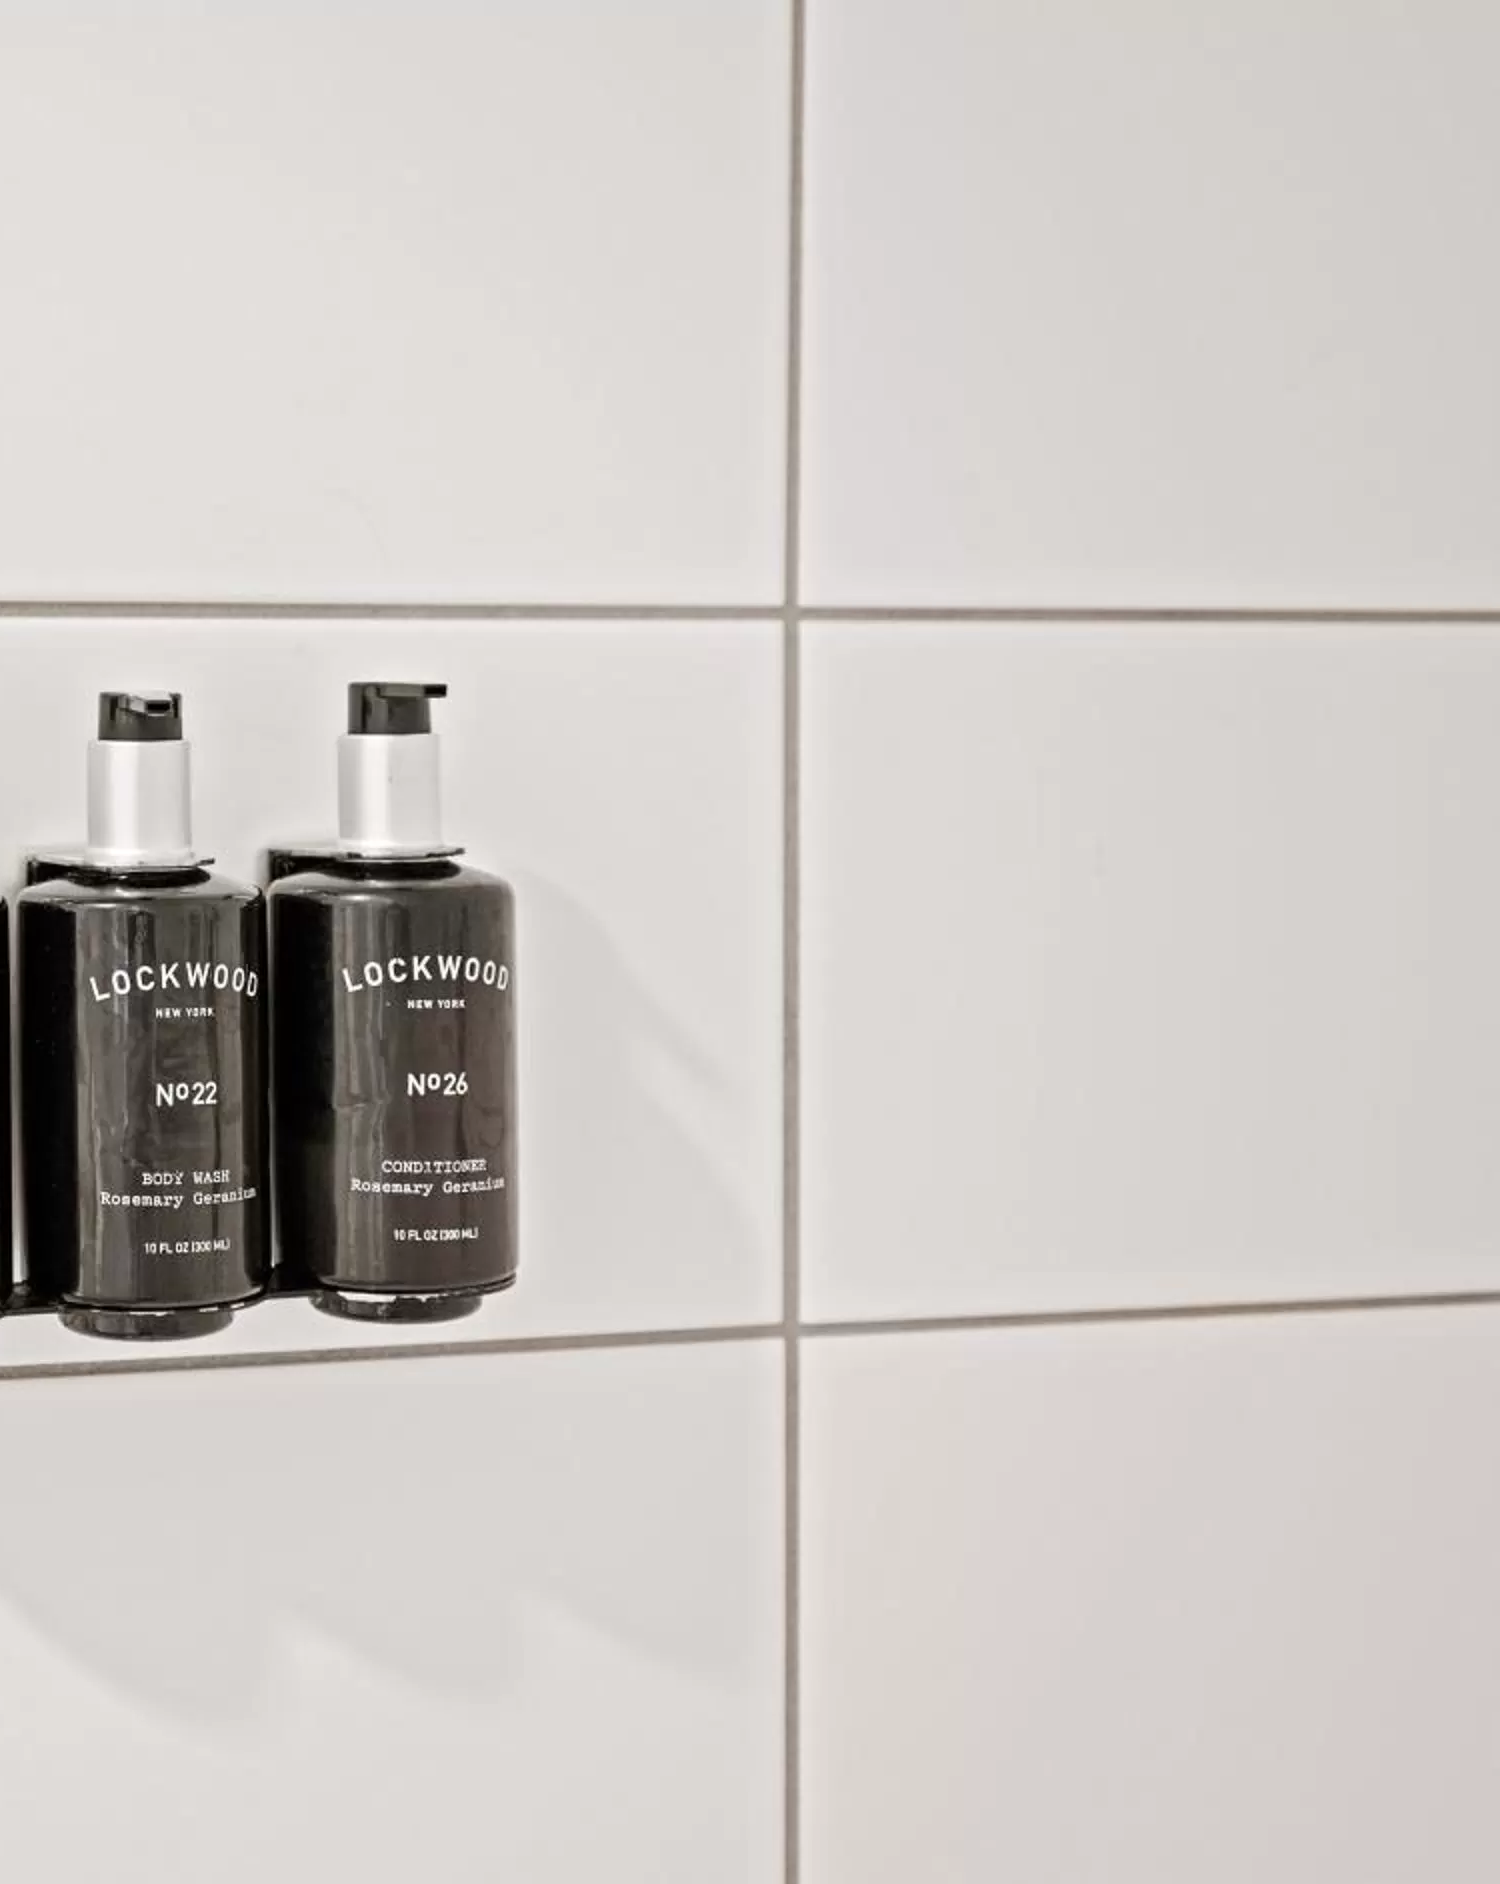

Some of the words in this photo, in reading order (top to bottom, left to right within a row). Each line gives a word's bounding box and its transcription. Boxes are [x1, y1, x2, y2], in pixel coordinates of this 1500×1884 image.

[89, 962, 259, 1002] LOCKWOOD
[341, 955, 509, 993] LOCKWOOD
[155, 1007, 182, 1018] NEW
[185, 1007, 214, 1018] YORK
[407, 999, 434, 1010] NEW
[437, 999, 466, 1010] YORK
[381, 1158, 487, 1174] CONDITIONER
[141, 1172, 183, 1186] BODY
[193, 1169, 230, 1184] WASH
[350, 1177, 434, 1197] Rosemary
[100, 1191, 184, 1209] Rosemary
[394, 1228, 406, 1241] 10
[145, 1242, 157, 1254] 10
[175, 1241, 189, 1253] OZ
